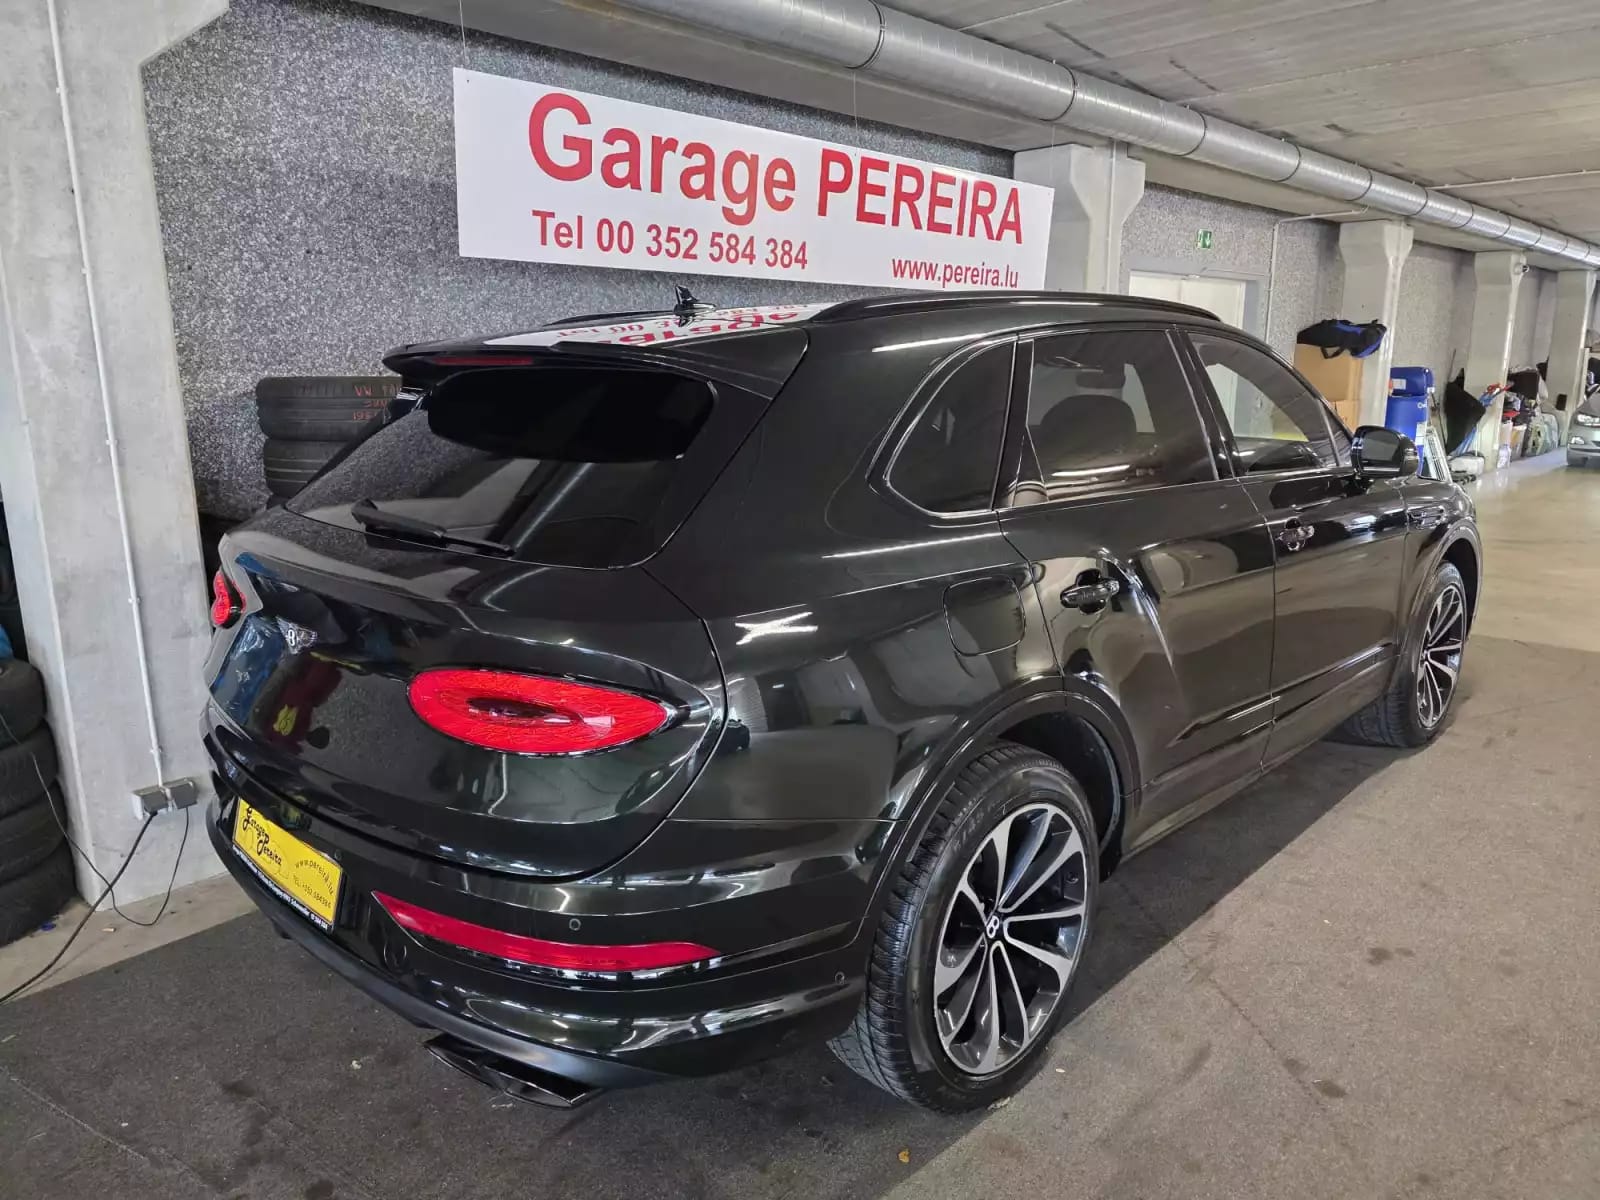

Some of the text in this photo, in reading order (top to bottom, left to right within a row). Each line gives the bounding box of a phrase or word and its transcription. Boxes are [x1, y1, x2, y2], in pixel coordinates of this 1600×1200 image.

[527, 91, 1024, 246] Garage PEREIRA
[531, 209, 808, 271] Tel 00 352 584 384
[891, 258, 1019, 289] www.pereira.lu
